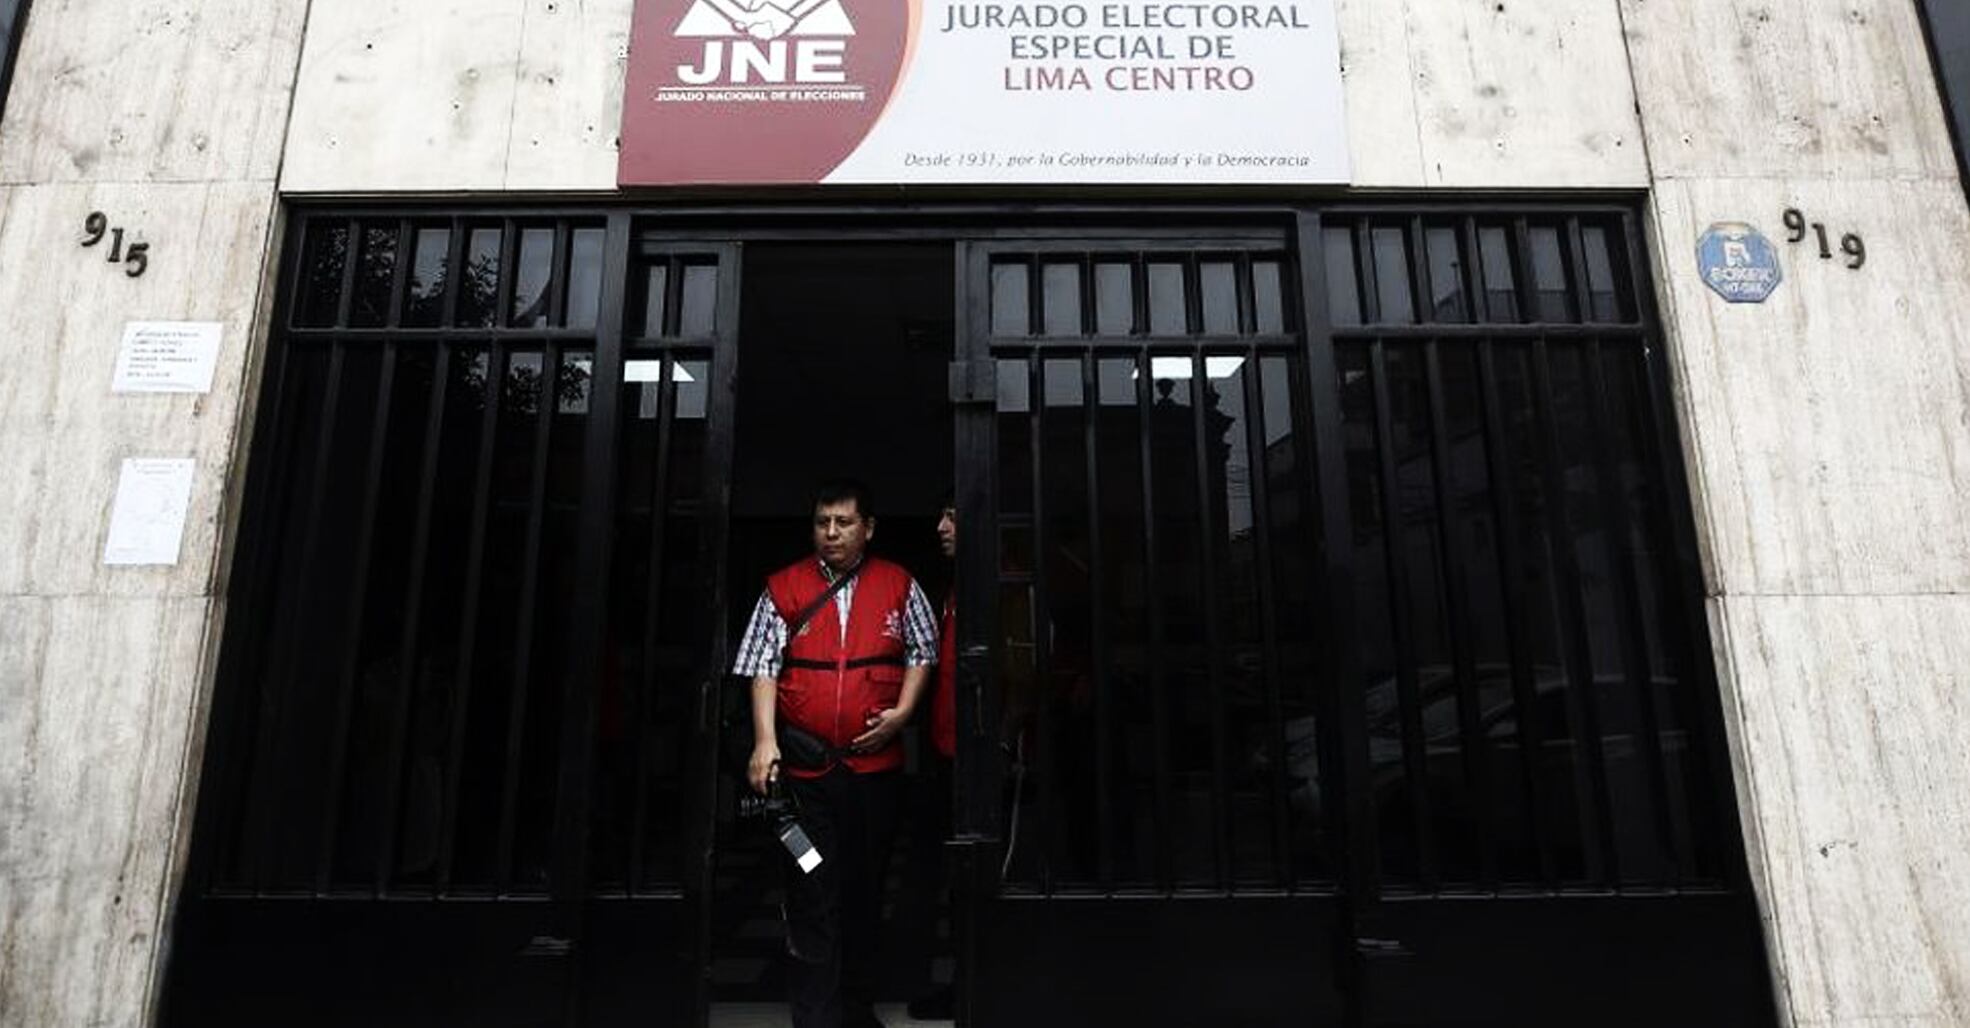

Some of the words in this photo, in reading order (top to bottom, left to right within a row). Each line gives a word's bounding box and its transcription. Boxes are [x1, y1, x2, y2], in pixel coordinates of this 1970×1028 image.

[941, 4, 1088, 32] JURADO
[1102, 4, 1310, 29] ELECTORAL
[1010, 35, 1175, 60] ESPECIAL
[1188, 35, 1236, 59] DE
[677, 40, 846, 85] JNE
[1004, 66, 1092, 91] LIMA
[1104, 66, 1254, 91] CENTRO
[656, 91, 704, 101] JURADO
[706, 91, 767, 101] NACIONAL
[770, 91, 785, 101] DE
[788, 90, 866, 101] ELECCIONES
[904, 151, 951, 167] Desde
[1006, 154, 1034, 170] por
[1039, 152, 1054, 167] la
[1058, 152, 1181, 168] Gobernabilidad
[1197, 153, 1212, 167] la
[1217, 153, 1311, 167] Democracia
[80, 210, 150, 278] 915
[1781, 207, 1867, 270] 919
